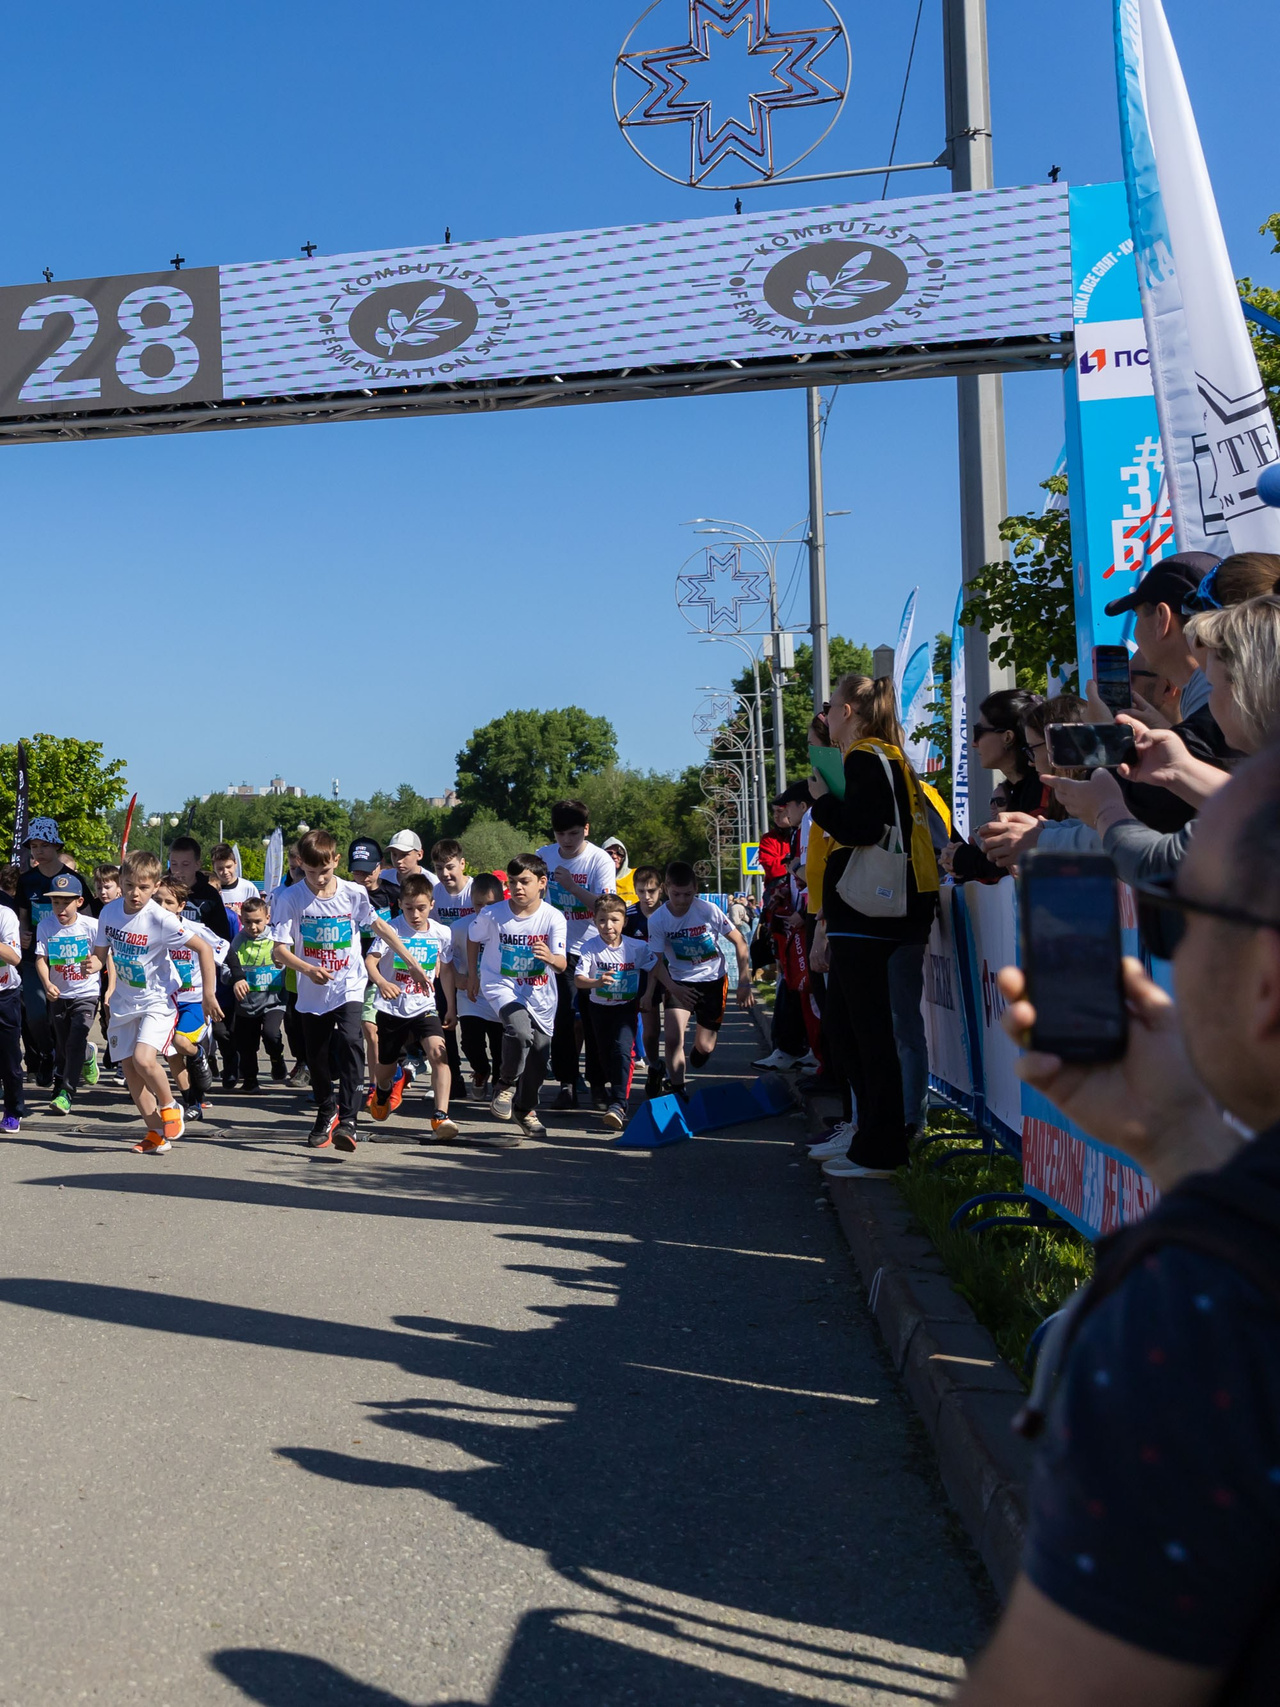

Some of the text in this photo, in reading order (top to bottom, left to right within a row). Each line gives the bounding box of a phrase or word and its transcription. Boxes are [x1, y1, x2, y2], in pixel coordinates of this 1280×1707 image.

[754, 221, 921, 256] KOMBUTIST
[340, 263, 488, 296] KOMBUTIST
[730, 274, 947, 345] FERMENTATION SKILL
[319, 312, 513, 379] FERMENTATION SKILL
[1114, 349, 1150, 368] ПС
[316, 926, 339, 942] 260
[59, 944, 78, 958] 283
[305, 947, 337, 959] ВМЕСТЕ
[512, 956, 534, 971] 295
